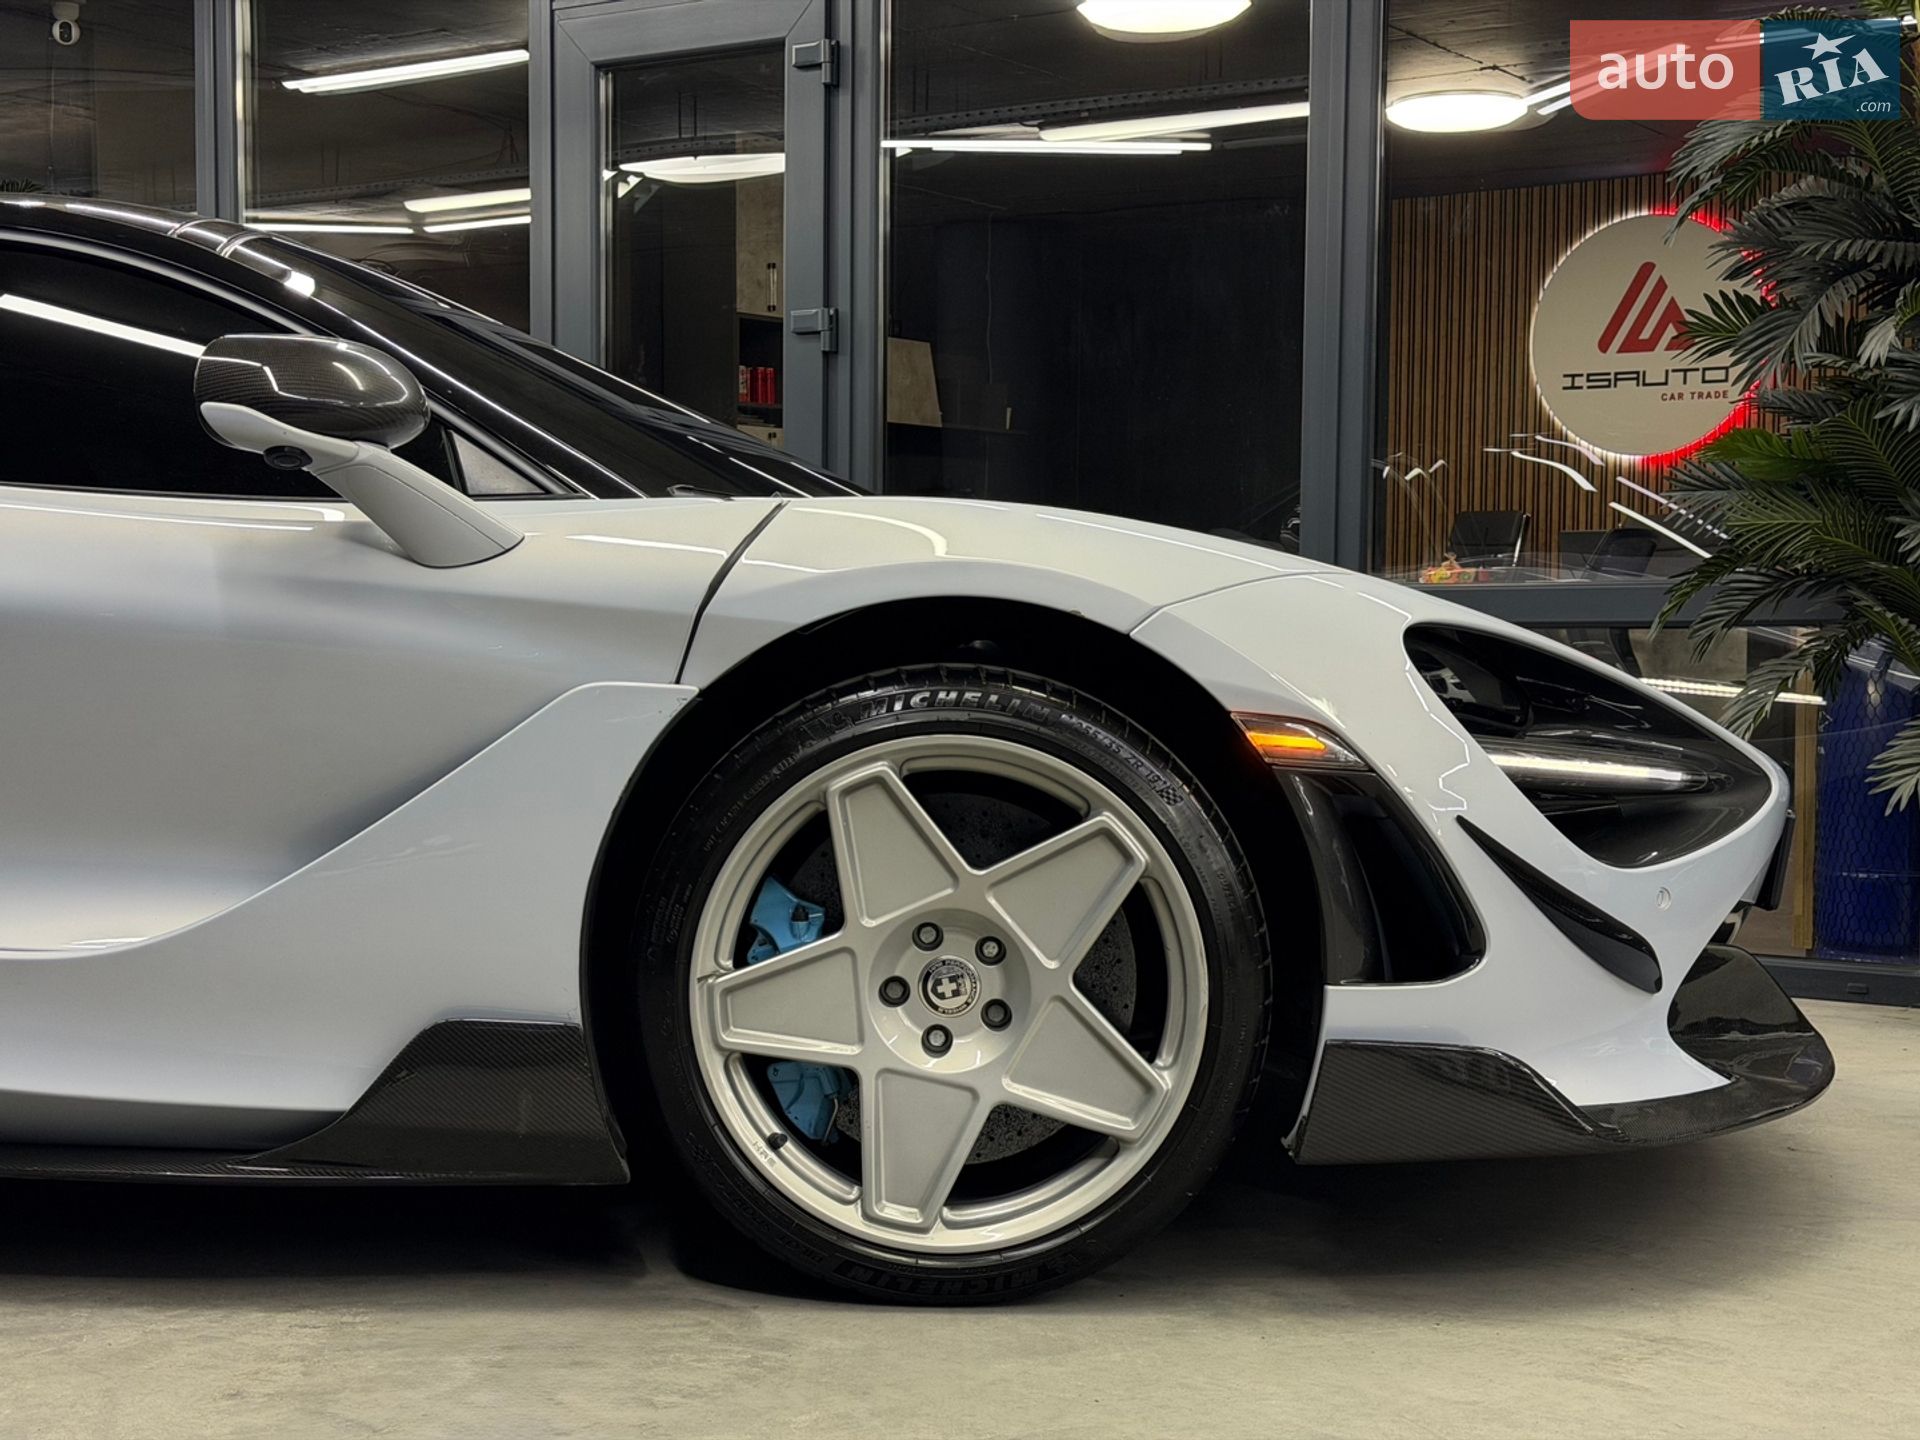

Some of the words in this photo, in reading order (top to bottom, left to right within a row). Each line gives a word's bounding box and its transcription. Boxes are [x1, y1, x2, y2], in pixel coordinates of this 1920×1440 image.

[1562, 367, 1730, 391] ISAUTO
[1661, 391, 1684, 402] CAR
[1689, 389, 1729, 401] TRADE
[860, 690, 1050, 720] MICHELIN
[1124, 752, 1144, 770] ZR
